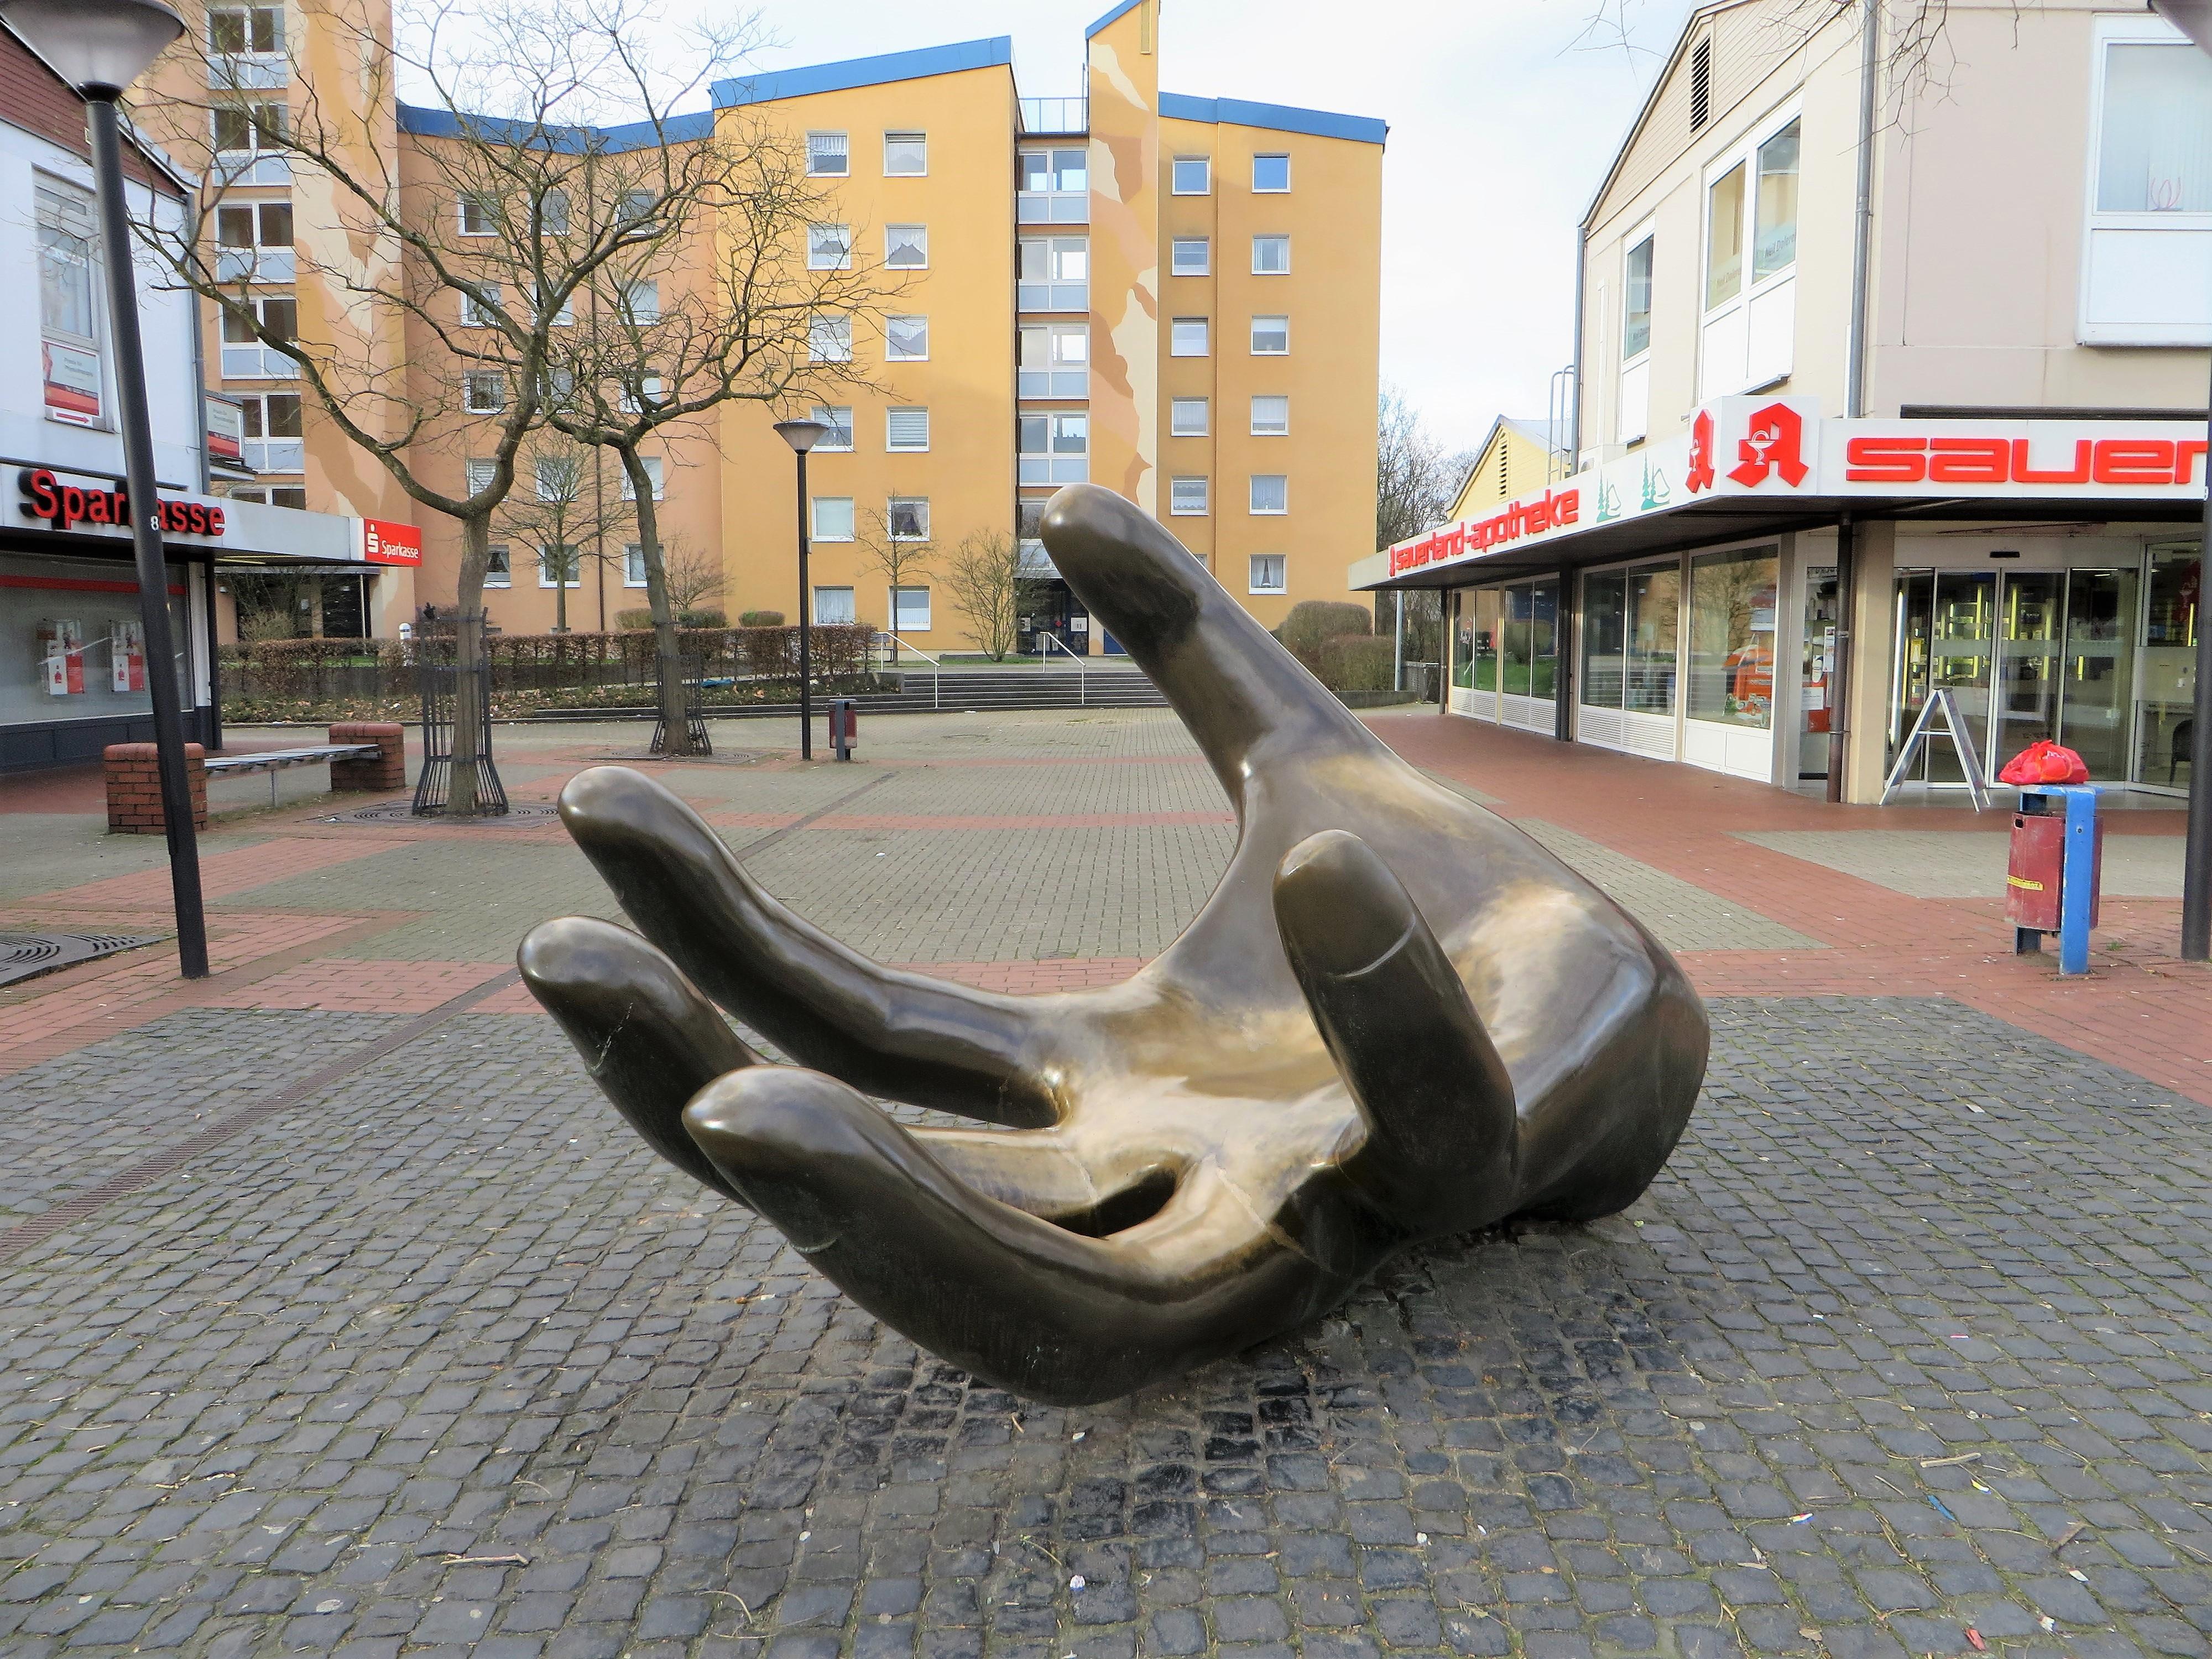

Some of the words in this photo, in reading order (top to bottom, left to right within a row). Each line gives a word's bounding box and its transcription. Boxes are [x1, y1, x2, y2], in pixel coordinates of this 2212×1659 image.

[1846, 437, 2209, 485] sauer
[30, 468, 226, 536] Sparasse
[150, 515, 159, 531] 8
[381, 540, 419, 559] Sparkasse
[1396, 488, 1579, 570] sauerland-apotheke
